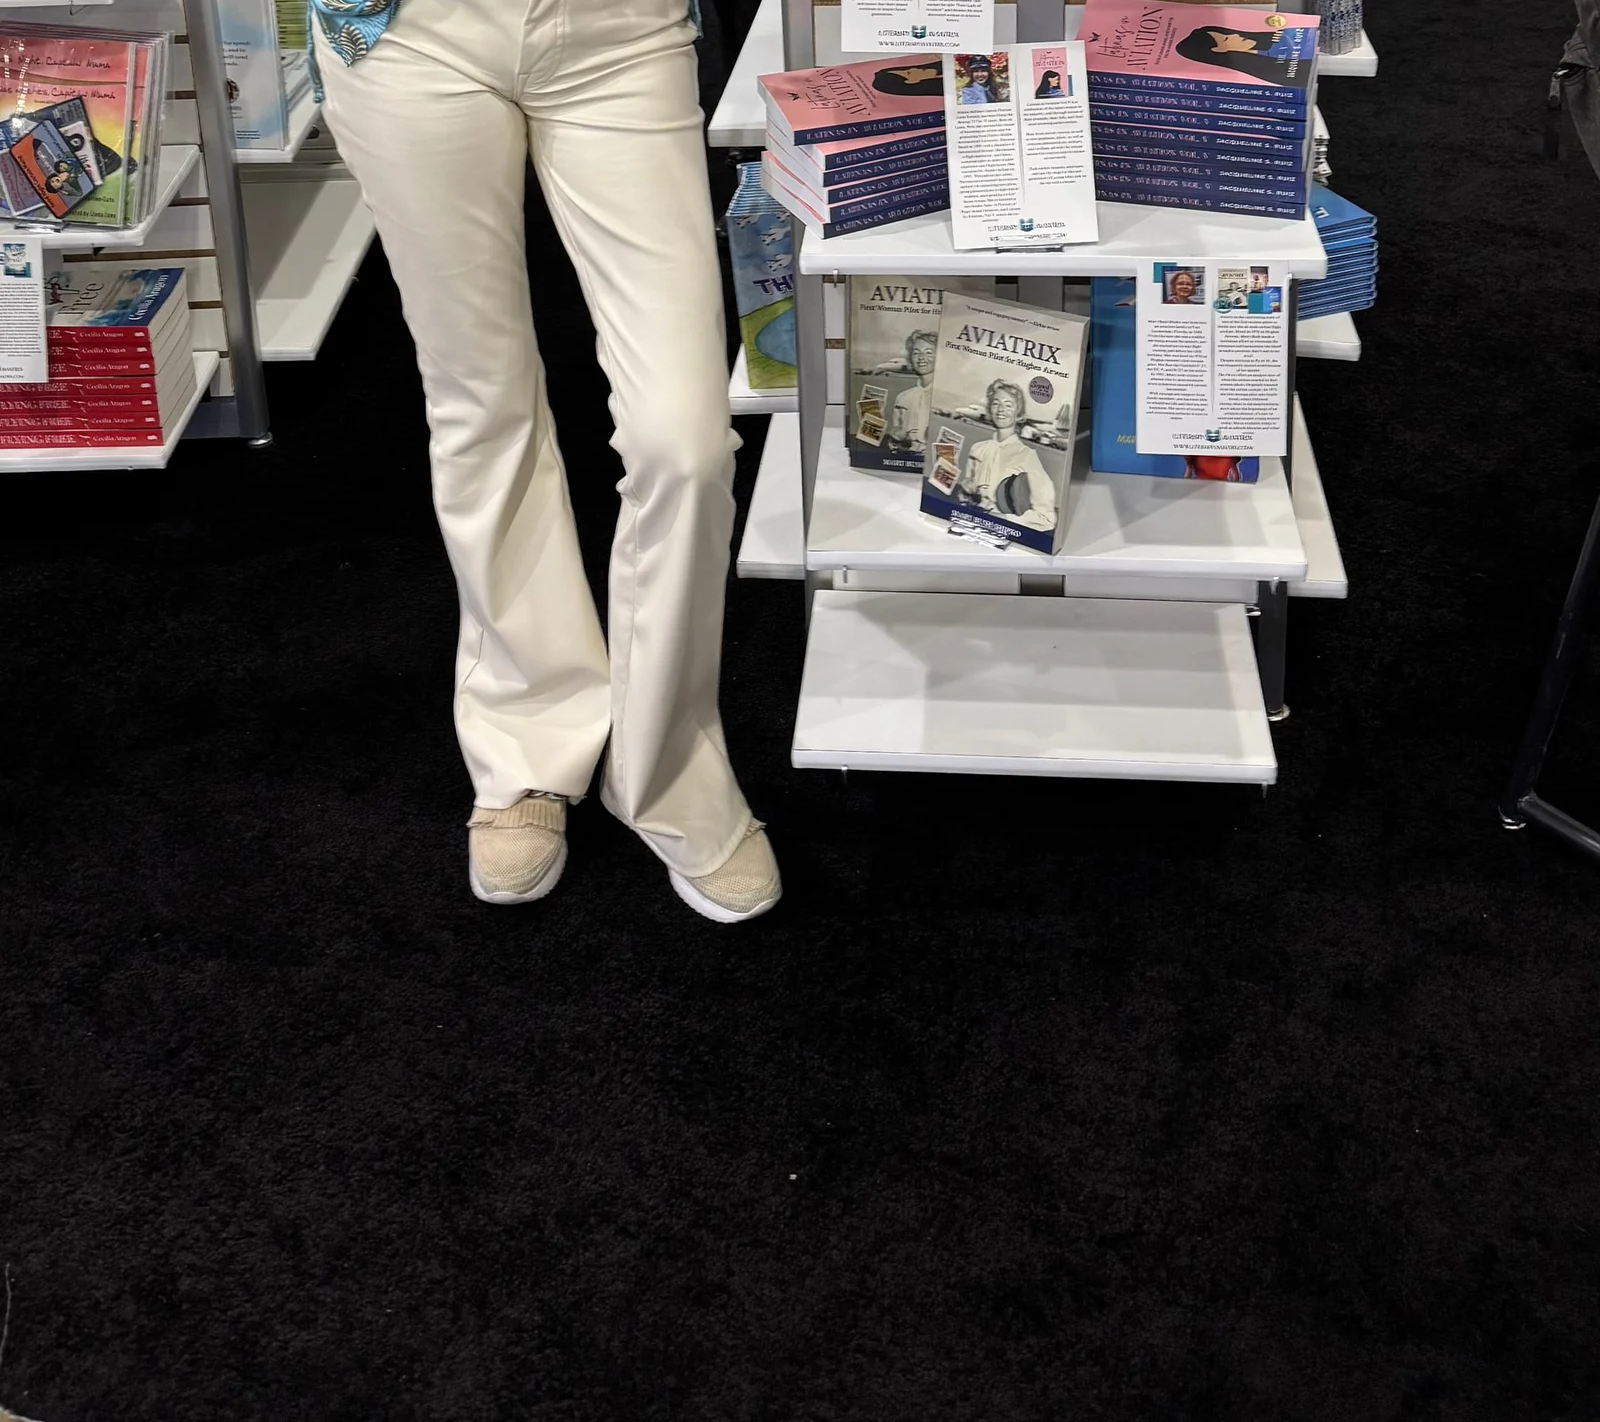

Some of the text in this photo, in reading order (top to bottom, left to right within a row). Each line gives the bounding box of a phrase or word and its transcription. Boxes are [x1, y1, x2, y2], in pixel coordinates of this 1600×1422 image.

[1126, 6, 1164, 71] AVIATION
[46, 56, 81, 69] Captain
[945, 341, 960, 350] First
[956, 324, 1061, 365] AVIATRIX
[1031, 380, 1050, 391] Signed
